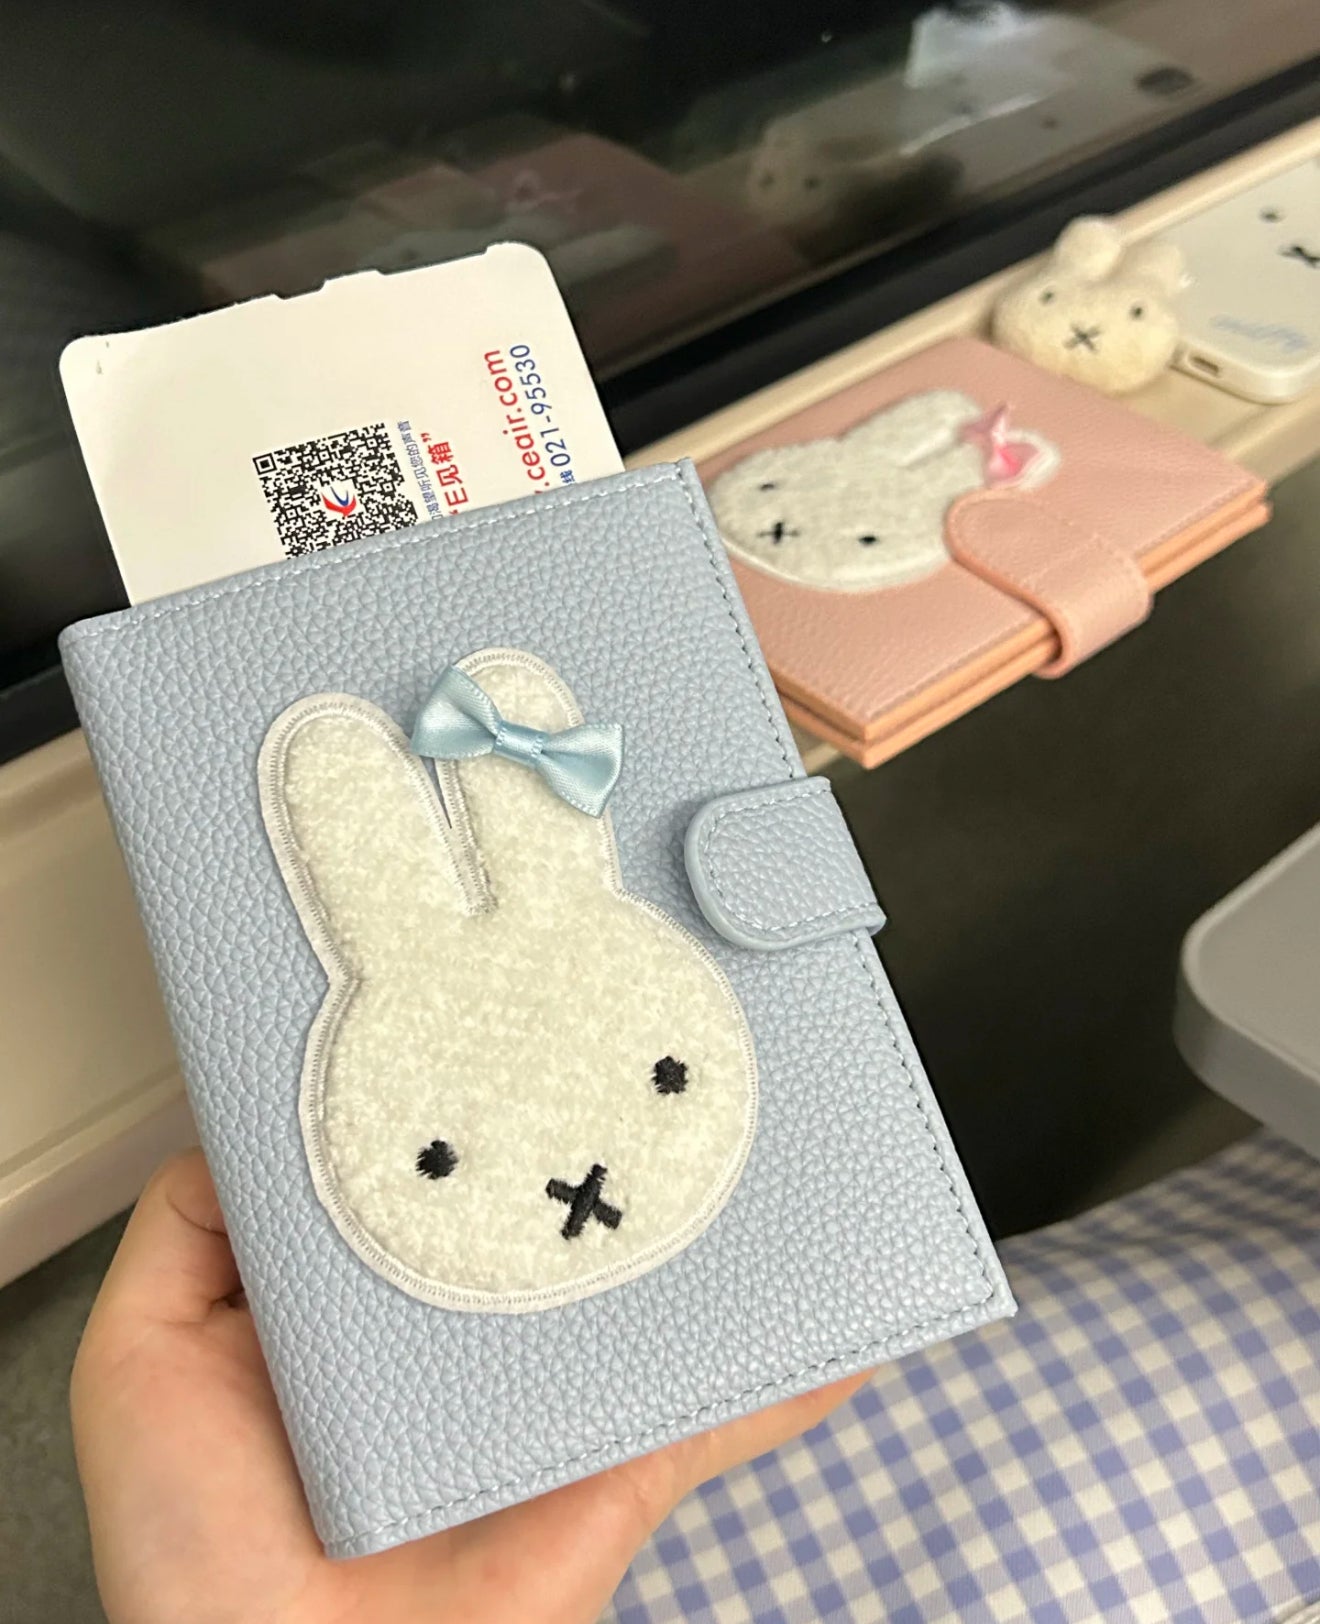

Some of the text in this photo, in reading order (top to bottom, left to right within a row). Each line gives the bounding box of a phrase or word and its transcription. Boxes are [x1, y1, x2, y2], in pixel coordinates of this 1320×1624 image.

[484, 349, 550, 494] .ceair.com
[509, 344, 577, 485] 线 021-95530
